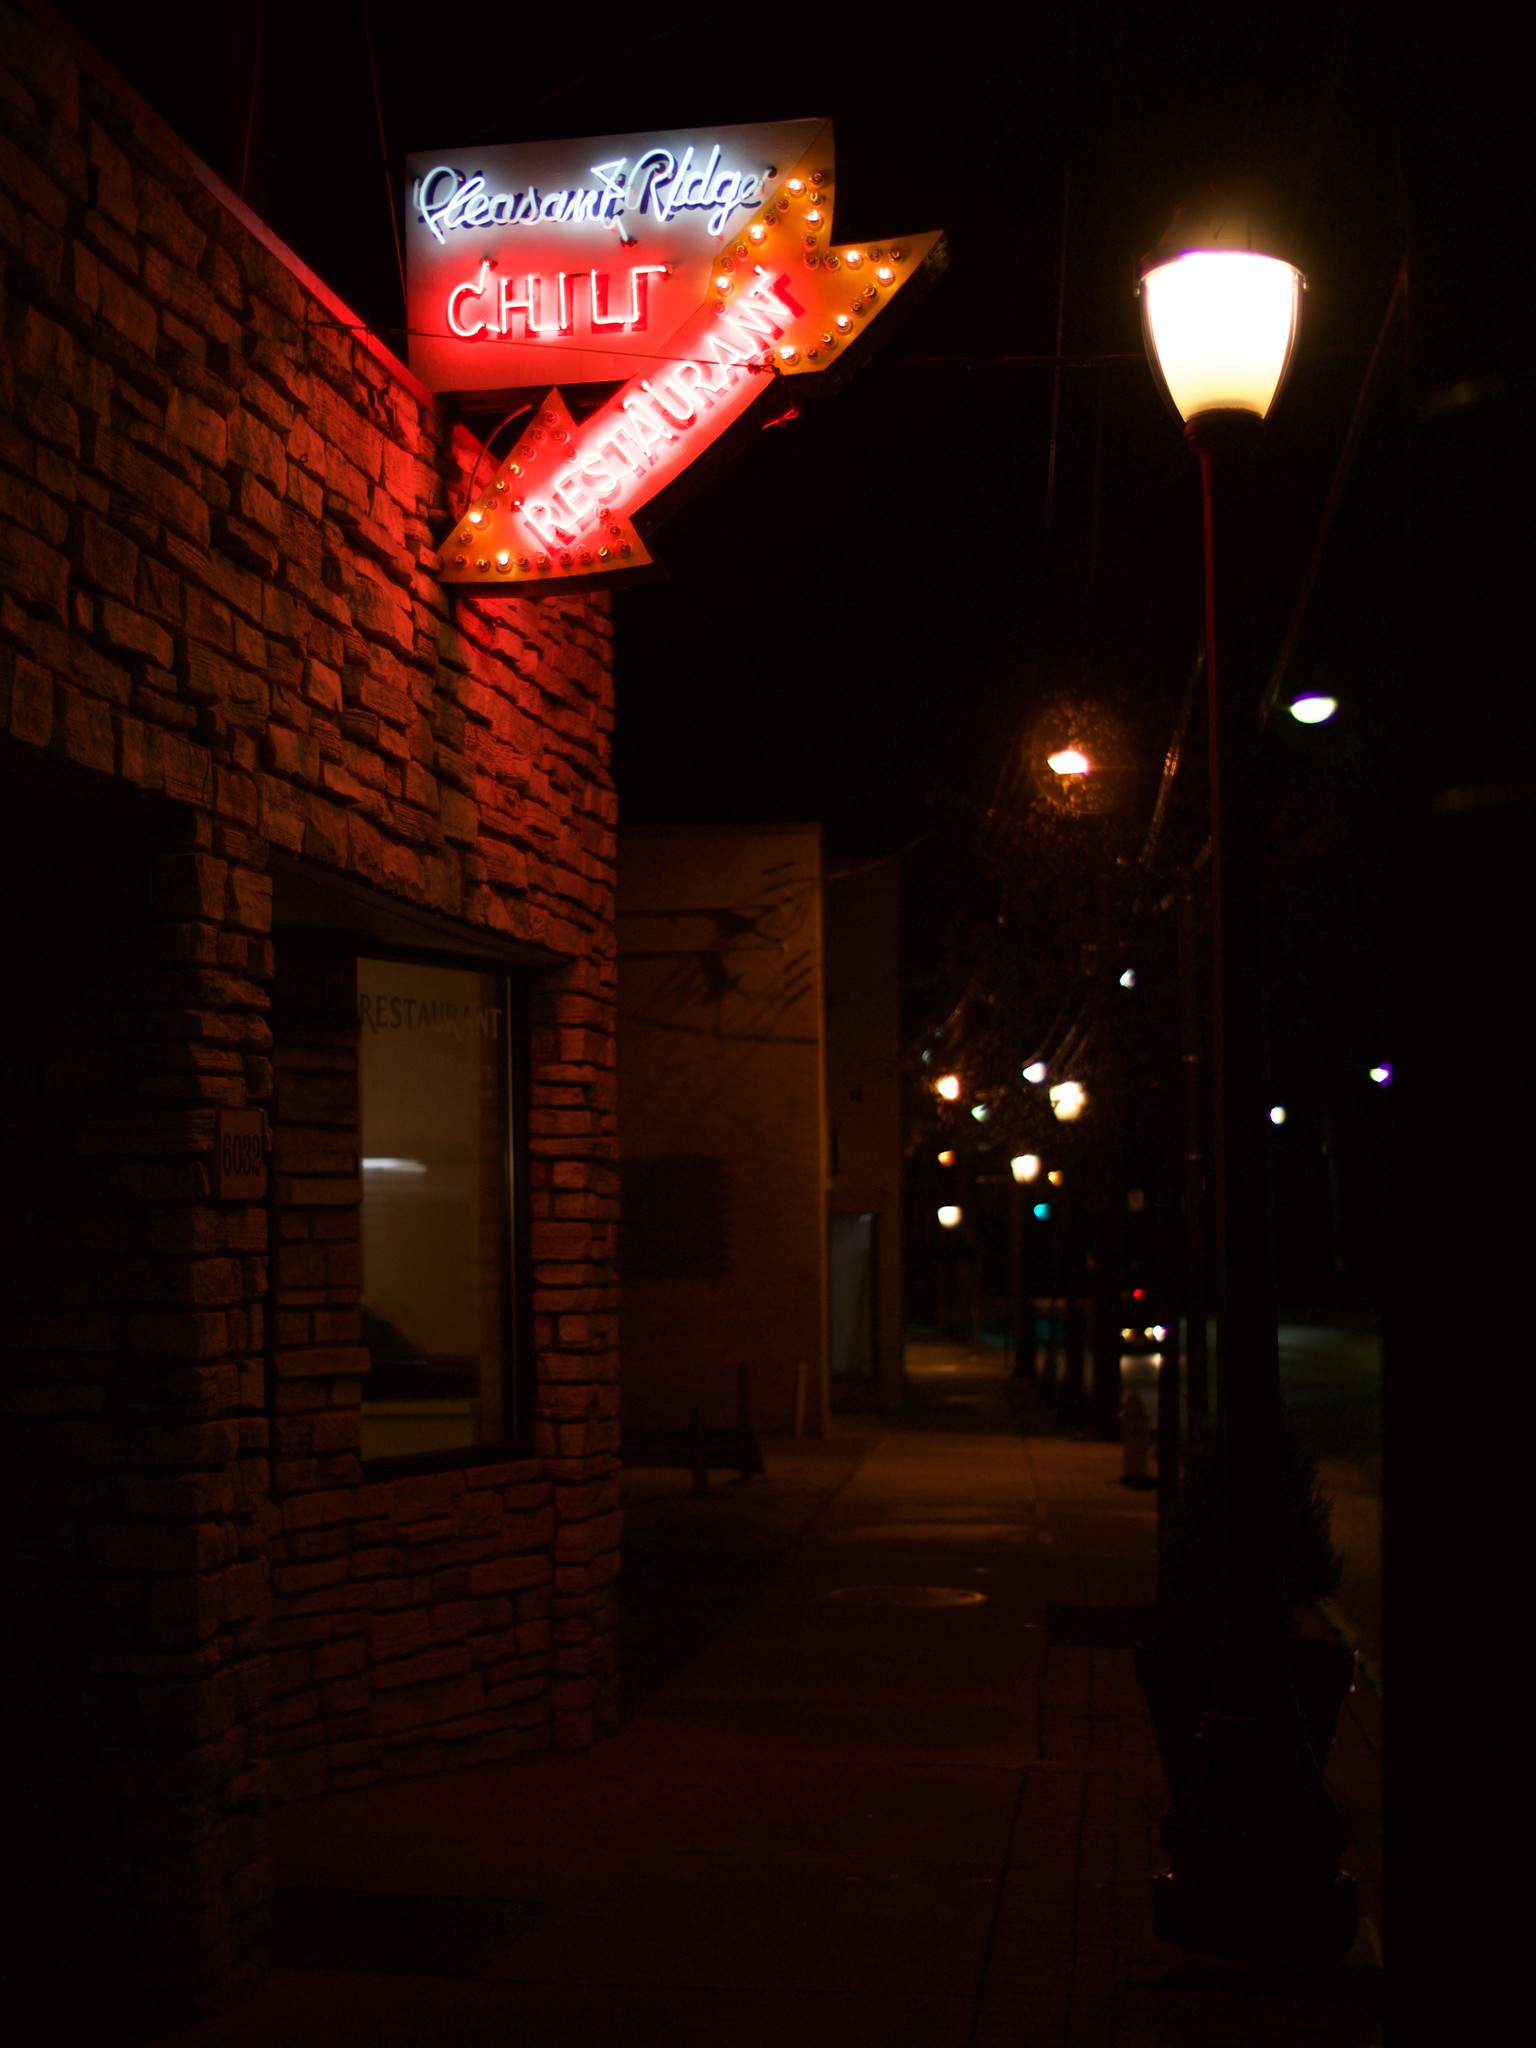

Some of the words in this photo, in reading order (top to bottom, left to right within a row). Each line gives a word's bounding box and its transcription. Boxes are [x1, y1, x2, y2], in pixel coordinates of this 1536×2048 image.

[415, 157, 628, 244] Pleasant
[623, 144, 766, 236] Ridge
[447, 260, 665, 337] CHILI
[518, 264, 800, 546] RESTAURANT
